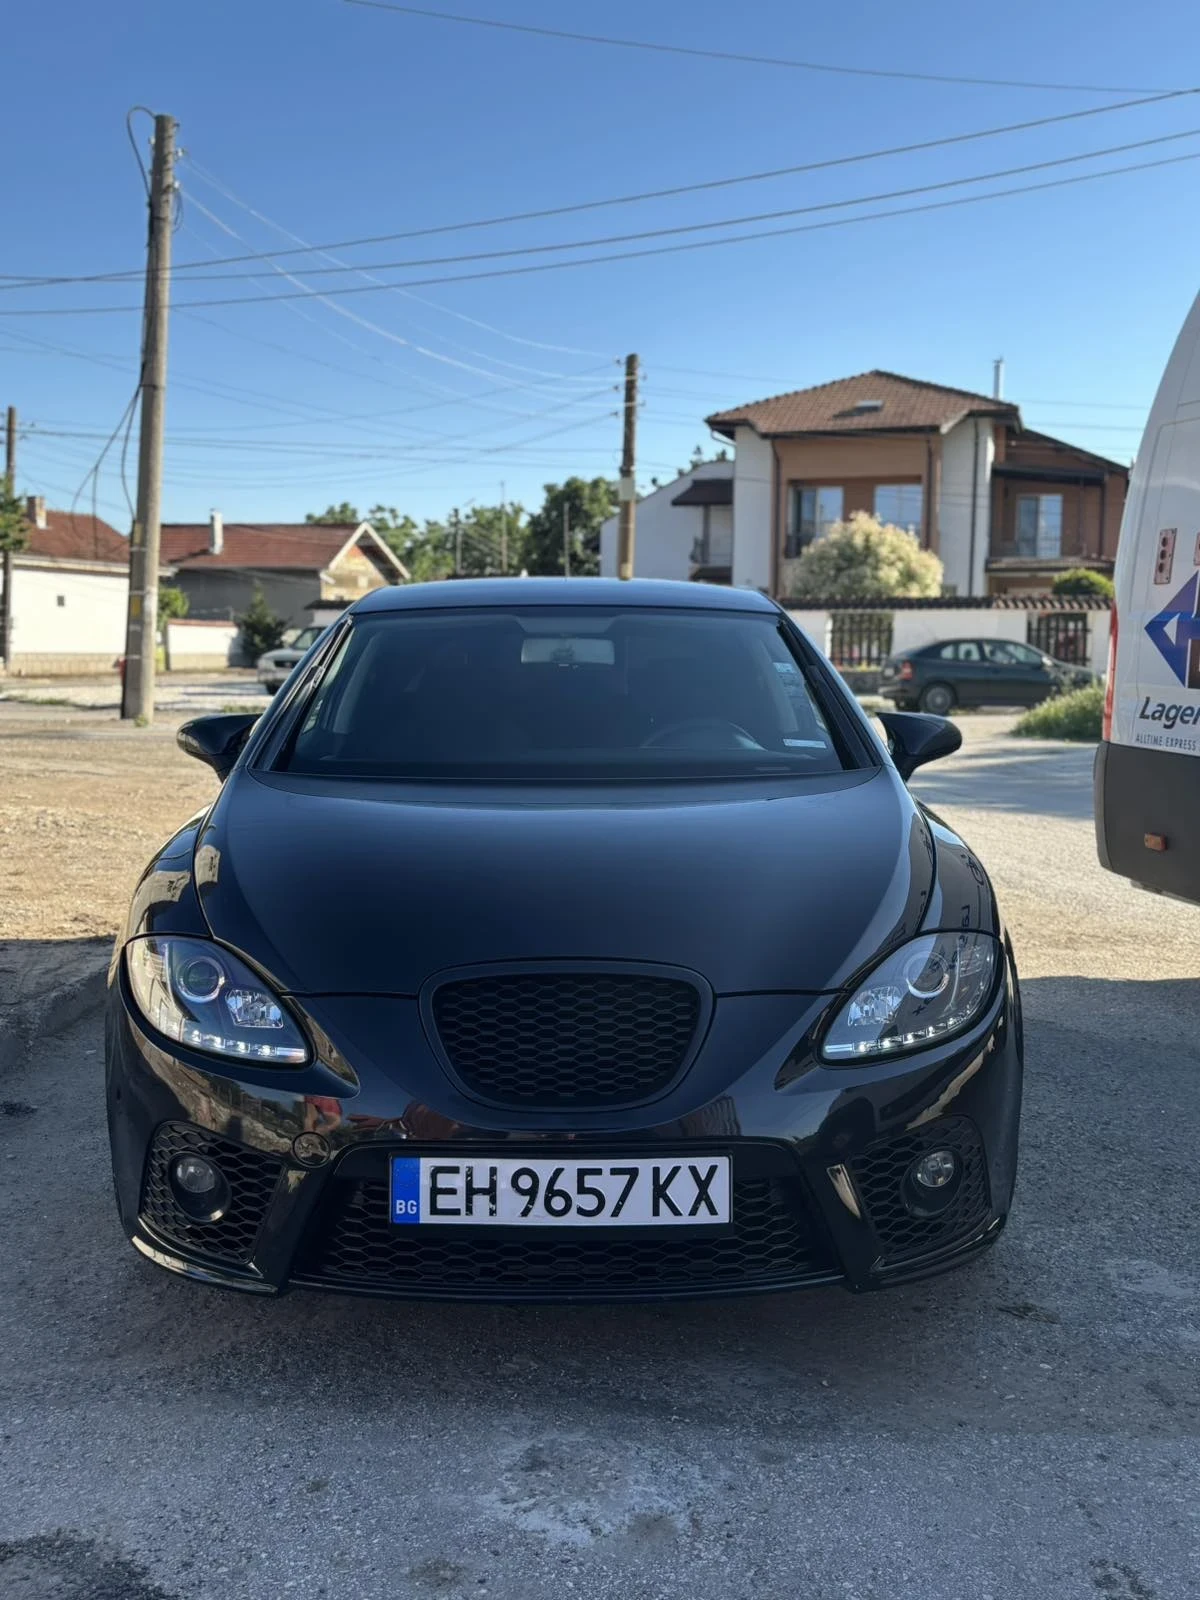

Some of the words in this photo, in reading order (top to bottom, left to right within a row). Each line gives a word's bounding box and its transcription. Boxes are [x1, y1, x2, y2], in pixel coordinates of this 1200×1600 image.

[1136, 733, 1163, 747] ALLTIME
[1165, 736, 1197, 751] EXPRESS
[429, 1165, 498, 1217] EH
[510, 1166, 640, 1218] 9657
[652, 1164, 719, 1217] KX
[395, 1199, 418, 1215] BG
